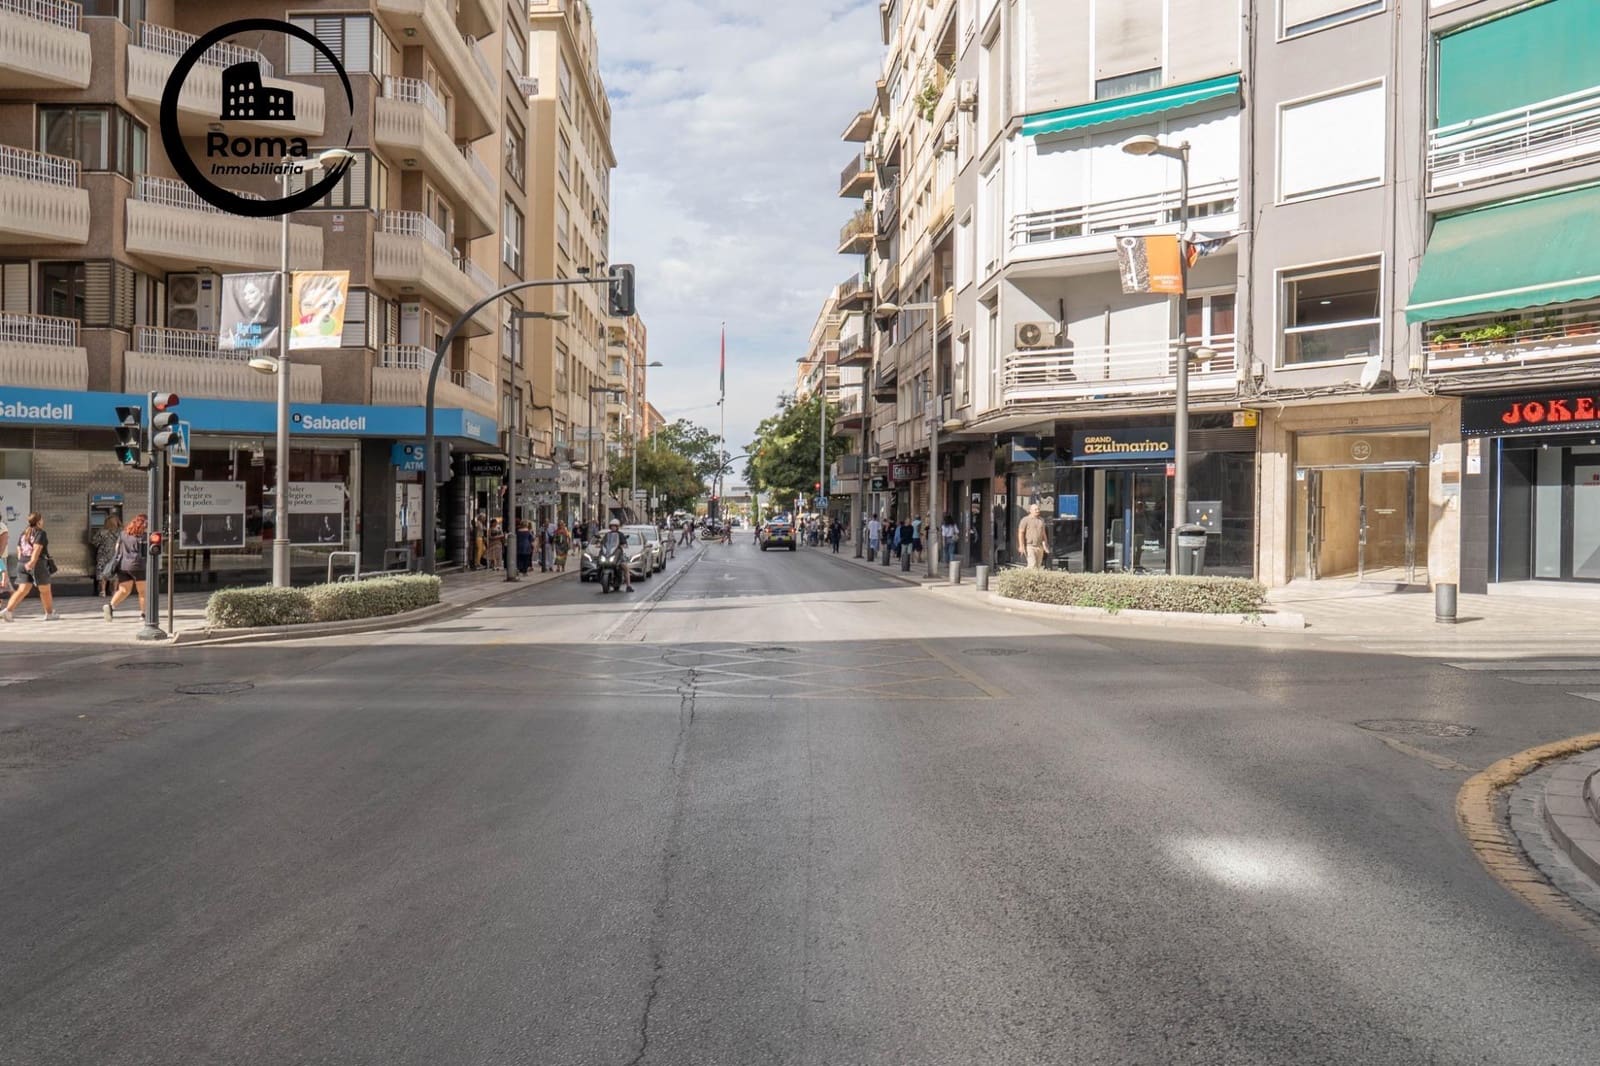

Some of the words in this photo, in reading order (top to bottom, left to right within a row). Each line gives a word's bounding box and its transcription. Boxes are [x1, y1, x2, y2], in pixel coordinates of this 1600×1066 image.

[1502, 397, 1600, 424] JOKE
[302, 415, 366, 430] Sabadell
[414, 447, 424, 460] S
[1084, 440, 1169, 454] azulmarino
[1354, 445, 1369, 454] 52
[404, 461, 424, 470] ATM
